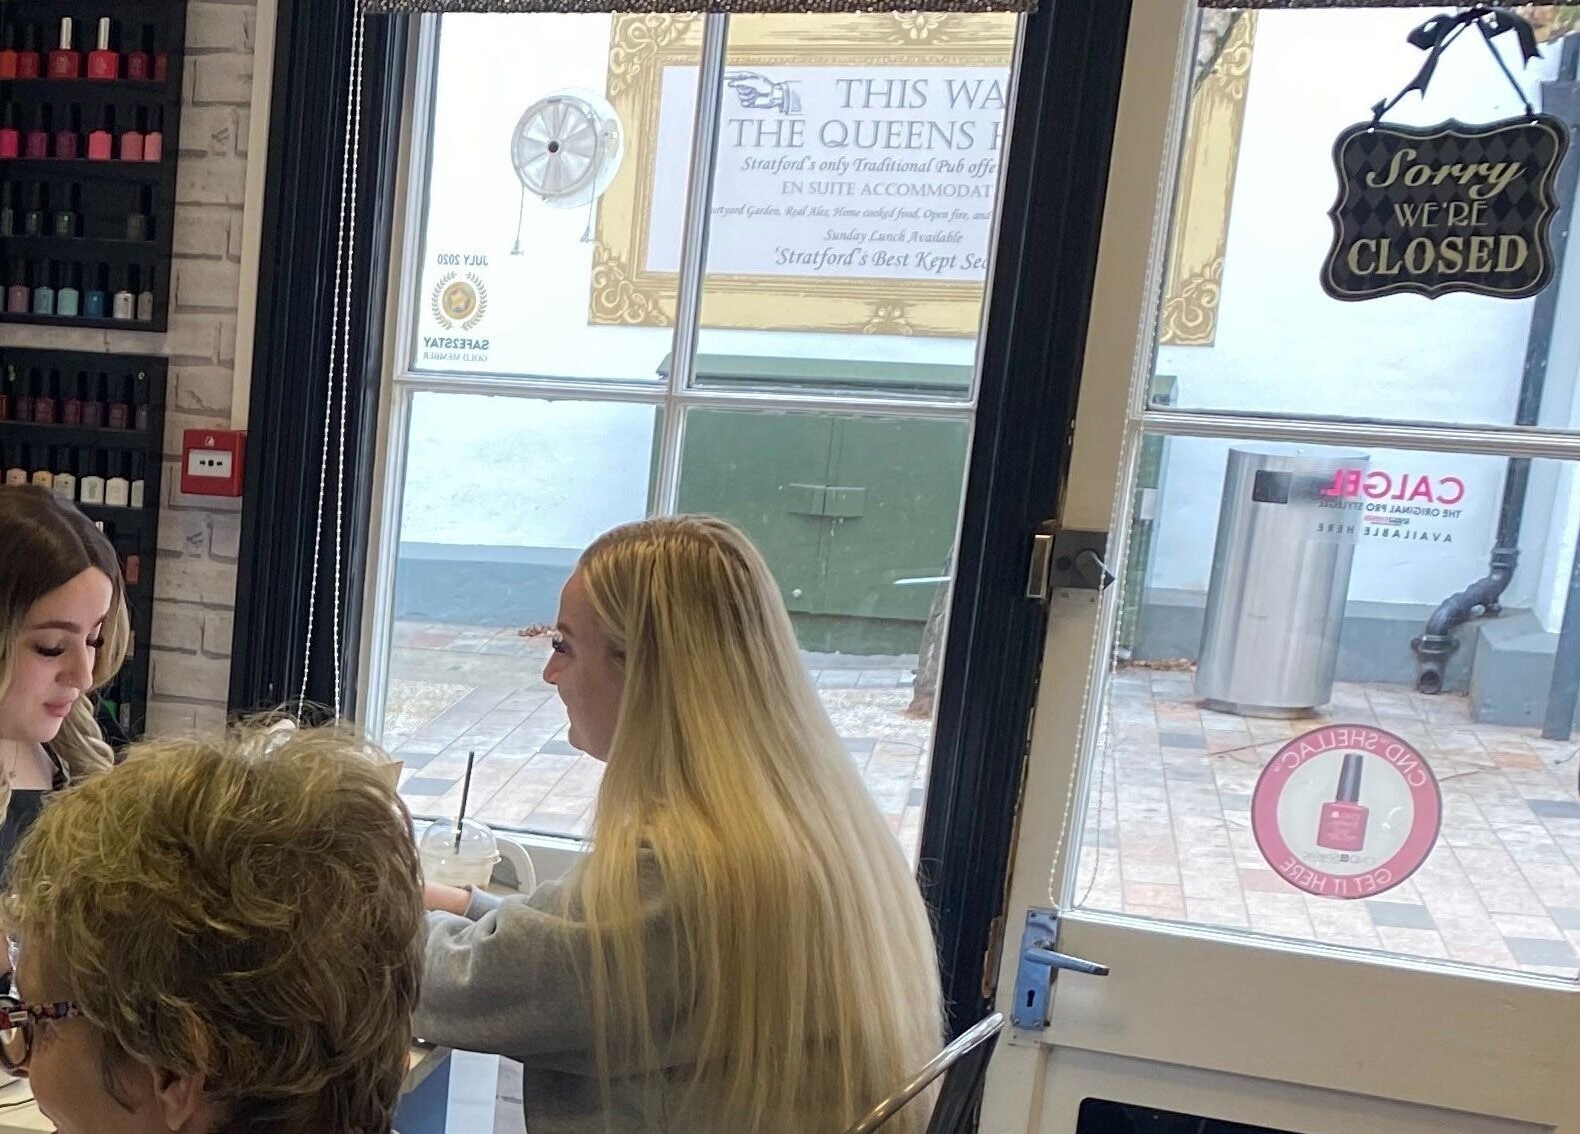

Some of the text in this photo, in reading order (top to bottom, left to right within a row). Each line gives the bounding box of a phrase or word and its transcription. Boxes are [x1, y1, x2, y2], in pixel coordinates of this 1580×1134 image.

[836, 78, 929, 109] THIS
[728, 119, 806, 148] THE
[819, 119, 976, 150] QUEENS
[740, 155, 817, 175] Stratford's
[819, 155, 850, 176] only
[852, 157, 936, 173] Traditional
[936, 157, 965, 174] Pub
[1366, 148, 1527, 200] Sorry
[781, 180, 804, 195] EN
[807, 181, 856, 196] SUITE
[923, 208, 948, 222] Open
[1394, 201, 1489, 228] WE'RE
[823, 227, 964, 244] Sunday Lunch Available
[871, 249, 910, 268] Best
[913, 251, 958, 274] Kept
[1347, 234, 1529, 276] CLOSED
